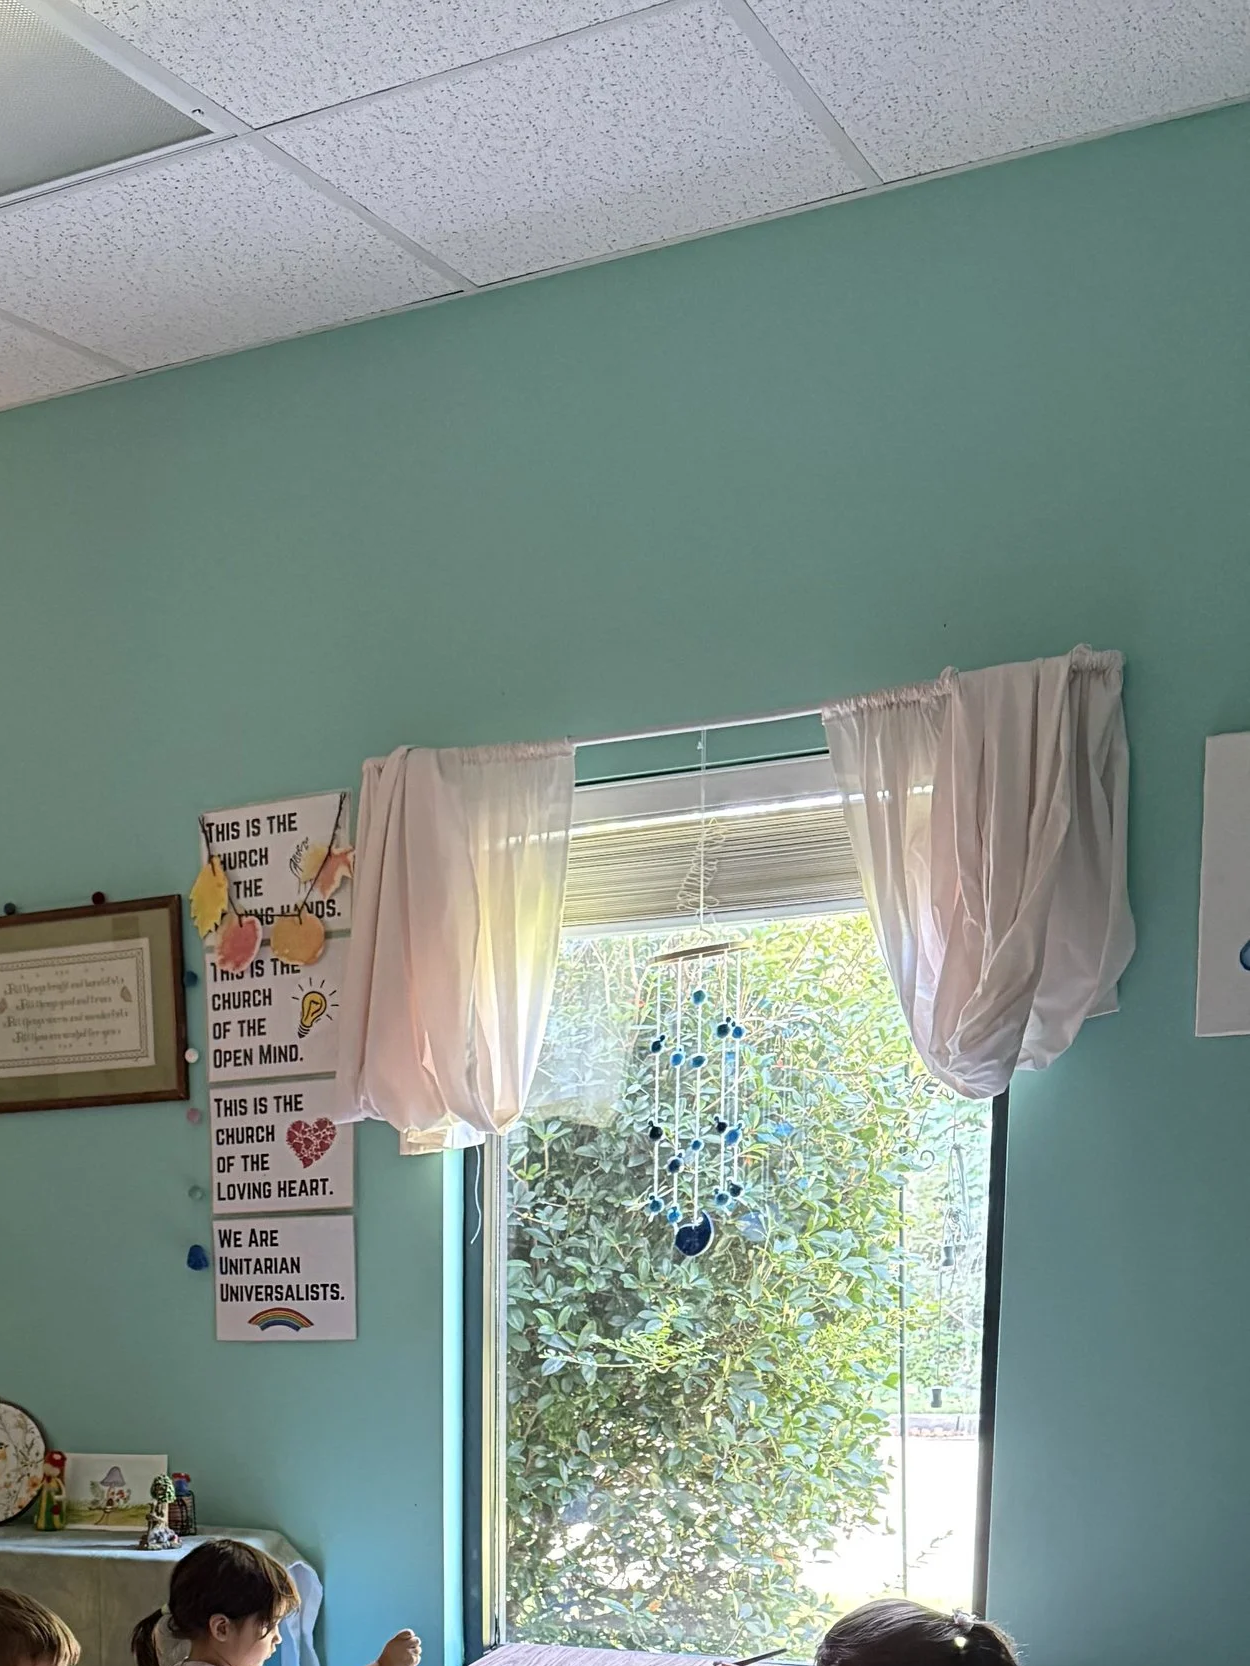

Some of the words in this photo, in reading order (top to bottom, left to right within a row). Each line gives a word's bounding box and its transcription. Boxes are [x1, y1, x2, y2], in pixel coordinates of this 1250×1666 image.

[206, 821, 240, 843] THIS
[246, 818, 261, 838] IS
[266, 812, 298, 835] THE
[218, 847, 269, 871] HURCH
[233, 878, 264, 899] THE
[250, 959, 265, 978] IS
[211, 988, 272, 1011] CHURCH
[213, 1021, 232, 1040] OF
[237, 1018, 266, 1037] THE
[213, 1047, 253, 1068] OPEN
[259, 1044, 304, 1065] MIND.
[214, 1098, 248, 1118] THIS
[253, 1097, 268, 1115] IS
[273, 1094, 303, 1113] THE
[215, 1124, 275, 1146] CHURCH
[217, 1155, 235, 1173] OF
[241, 1153, 270, 1172] THE
[217, 1180, 272, 1202] LOVING
[277, 1178, 334, 1198] HEART.
[218, 1228, 243, 1248] WE
[248, 1228, 279, 1248] ARE
[219, 1256, 301, 1275] UNITARIAN
[219, 1282, 345, 1302] UNIVERSALISTS.
